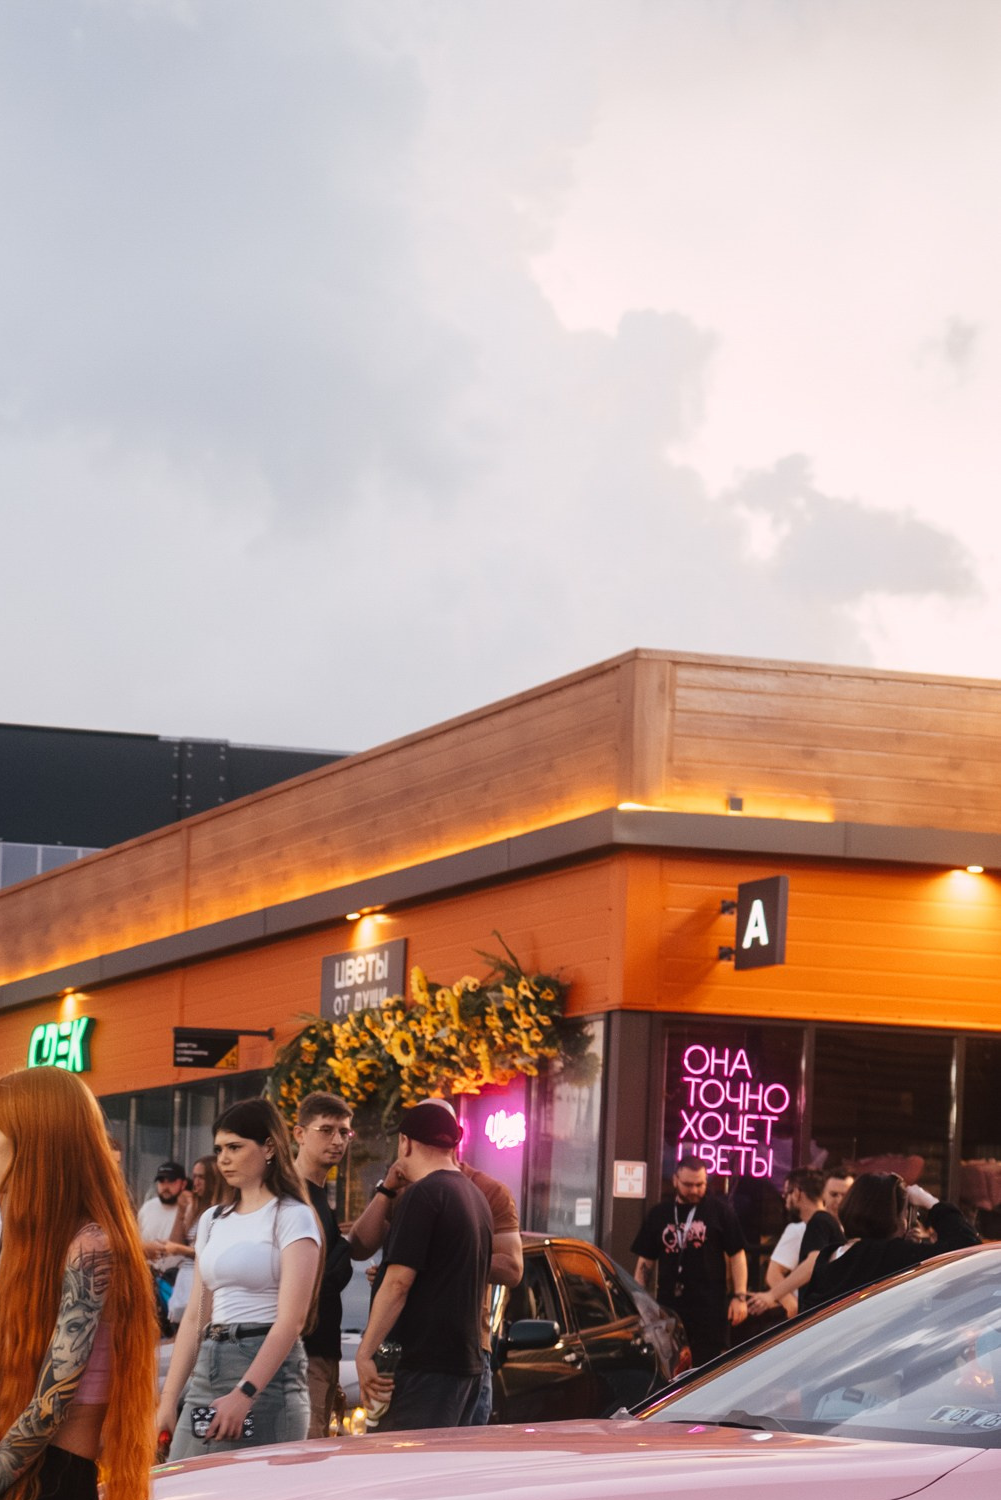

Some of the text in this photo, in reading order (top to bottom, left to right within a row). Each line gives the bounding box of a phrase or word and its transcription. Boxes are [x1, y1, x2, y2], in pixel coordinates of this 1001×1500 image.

[741, 898, 770, 949] А
[683, 1044, 753, 1079] ОНА
[682, 1076, 790, 1114] ТОЧНО
[679, 1109, 779, 1146] ХОЧЕТ
